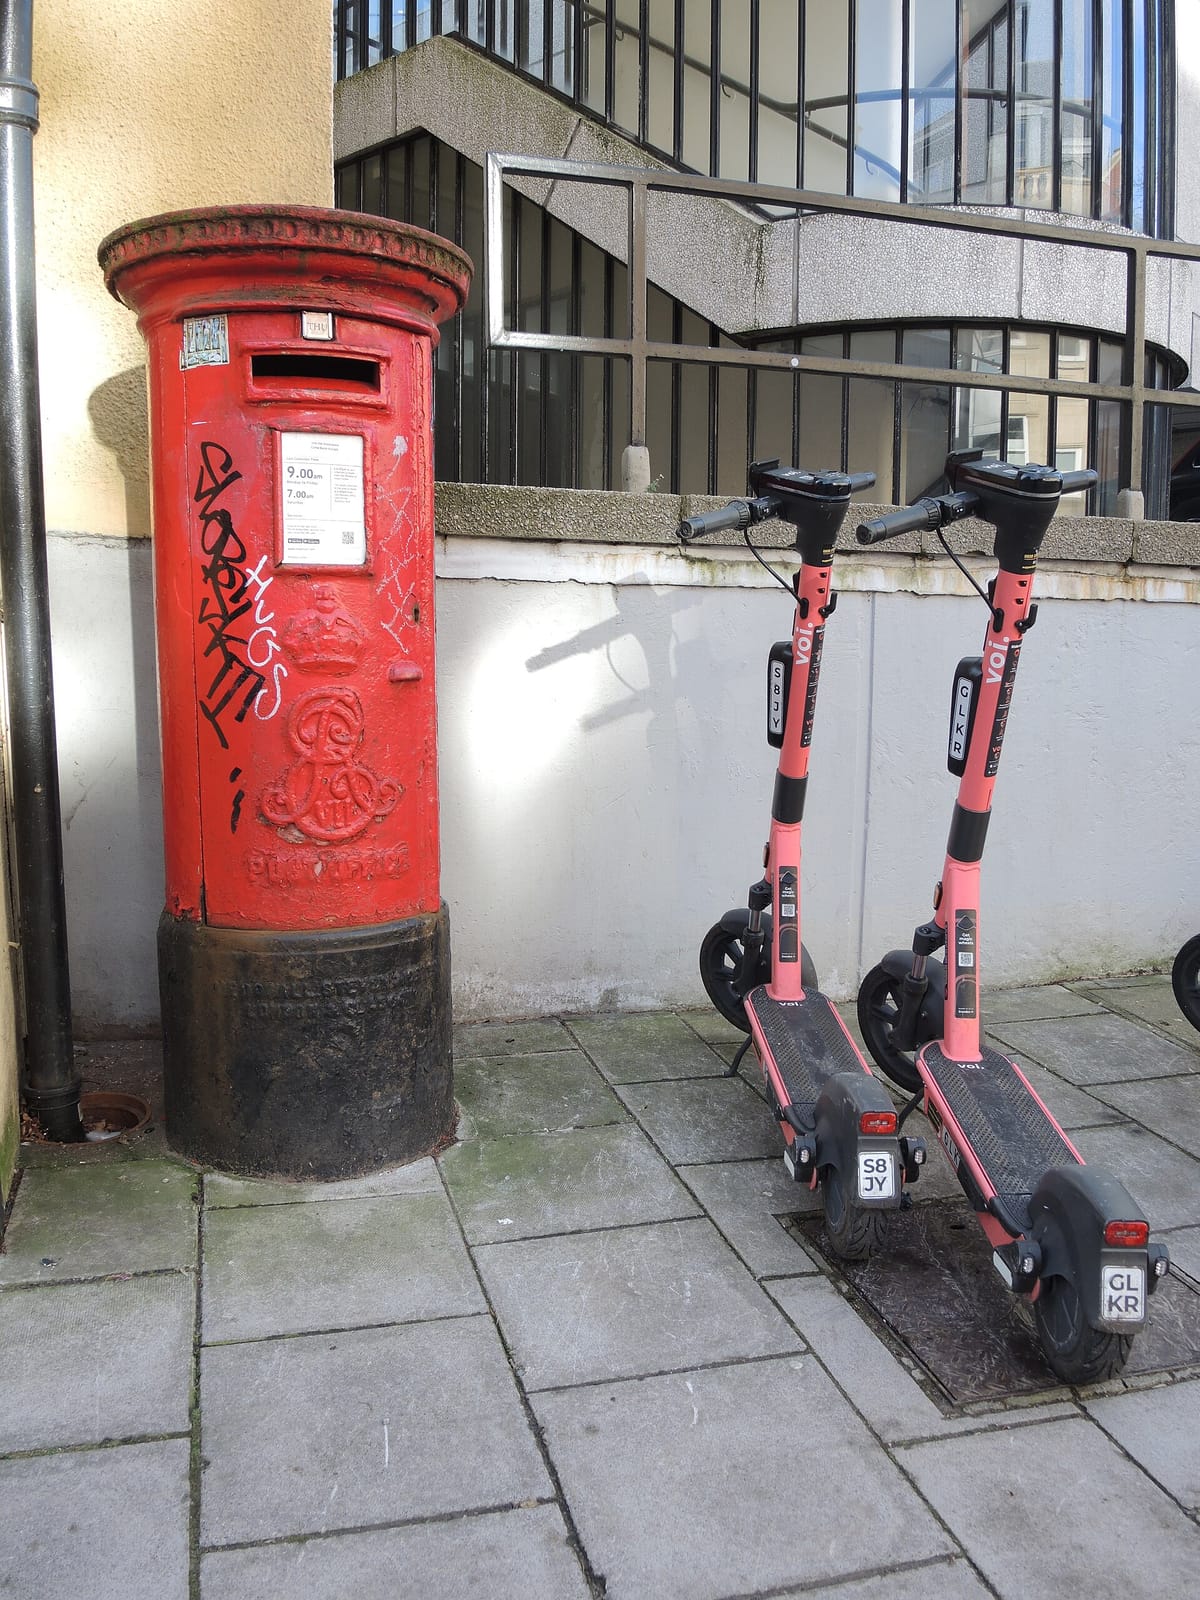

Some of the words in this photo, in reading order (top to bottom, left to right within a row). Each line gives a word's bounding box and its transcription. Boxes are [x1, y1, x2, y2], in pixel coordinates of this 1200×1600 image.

[306, 322, 328, 331] THU
[796, 622, 813, 665] voi.
[986, 636, 1009, 684] voi.
[957, 1062, 984, 1070] voi.
[863, 1158, 887, 1174] S8
[863, 1176, 887, 1192] JY
[1109, 1273, 1139, 1292] GL
[1108, 1295, 1139, 1313] KR
